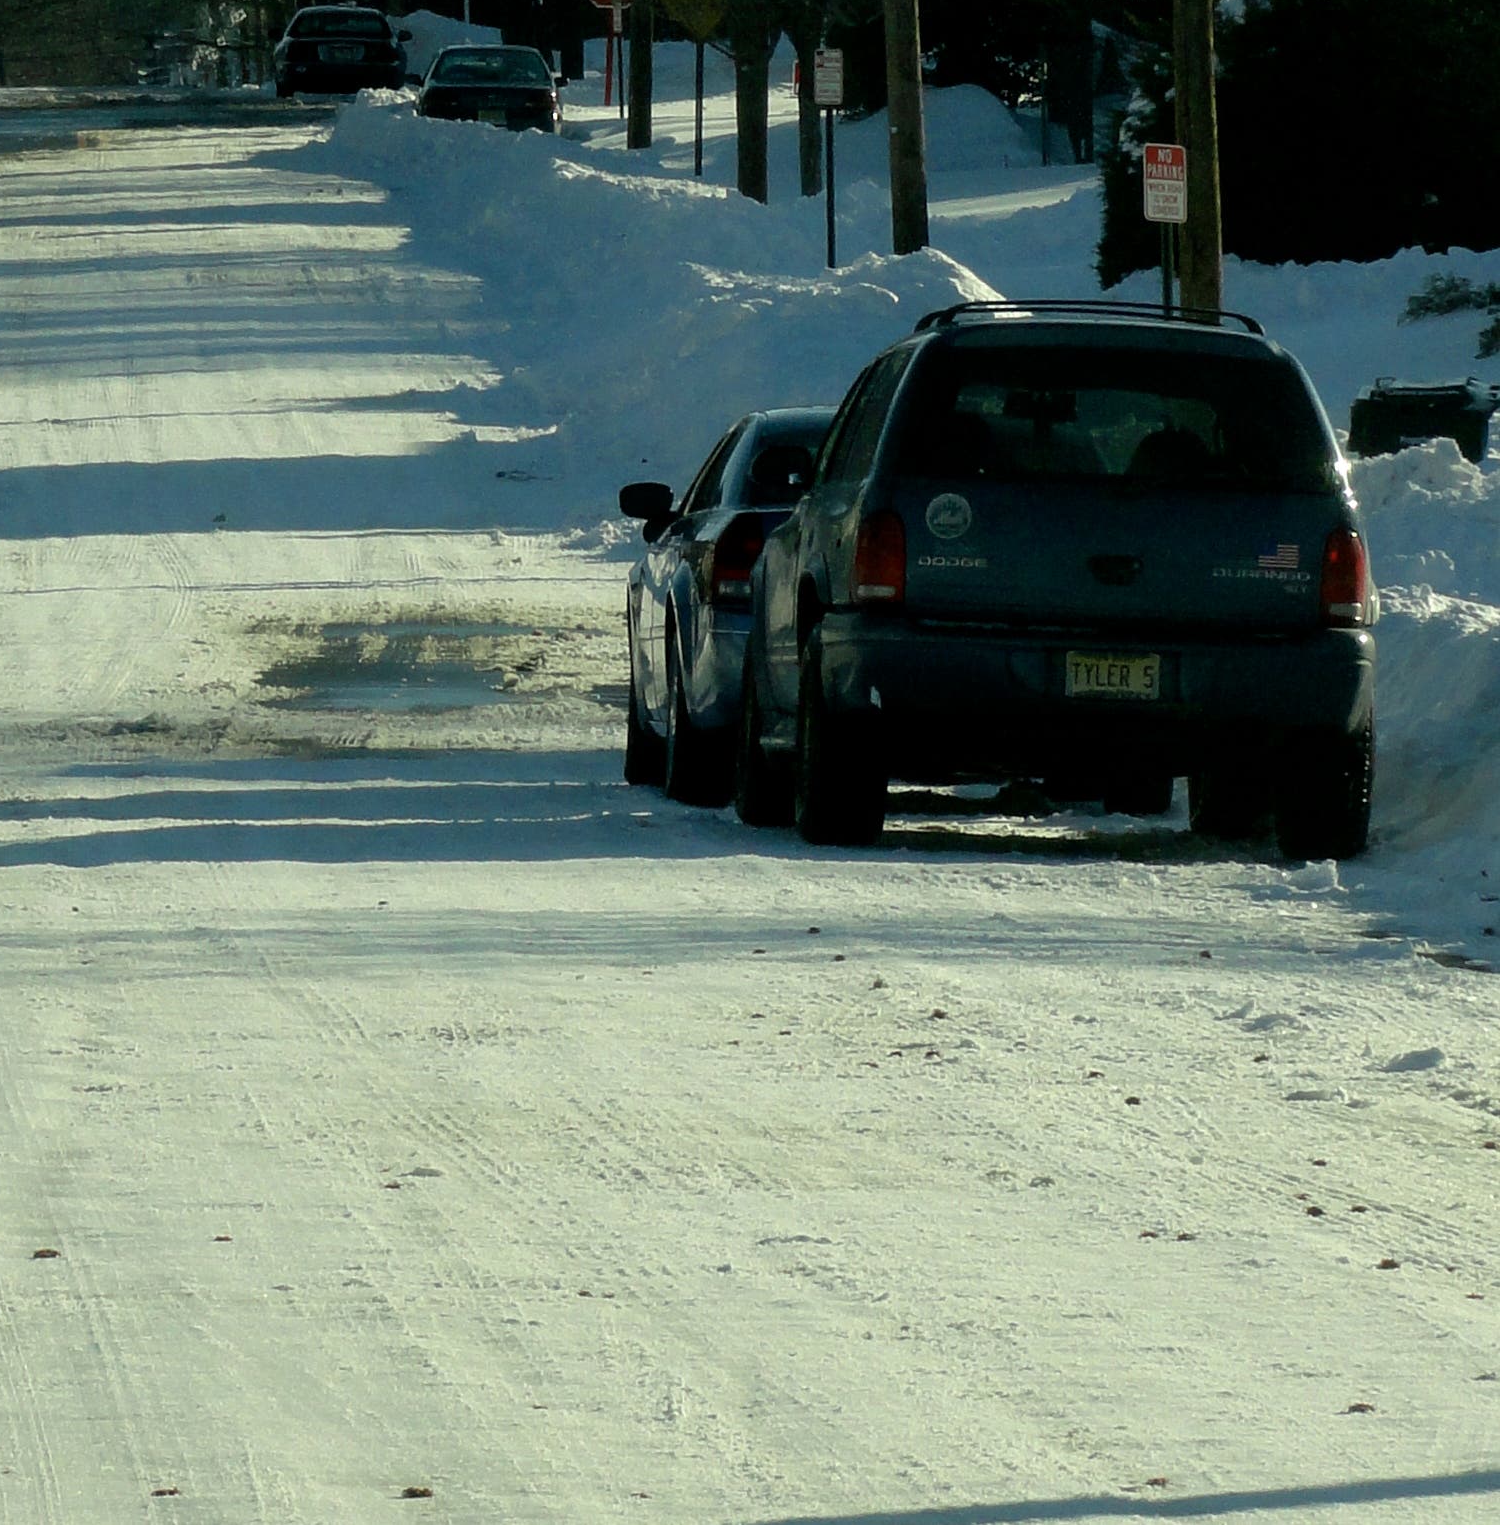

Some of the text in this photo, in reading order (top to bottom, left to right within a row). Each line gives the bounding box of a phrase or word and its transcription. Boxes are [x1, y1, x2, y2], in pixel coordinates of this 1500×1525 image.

[1157, 148, 1172, 164] NO
[1147, 163, 1184, 180] PARKING
[918, 555, 989, 568] DODGE
[1211, 567, 1311, 582] DURANGO
[1073, 662, 1129, 688] TYLER
